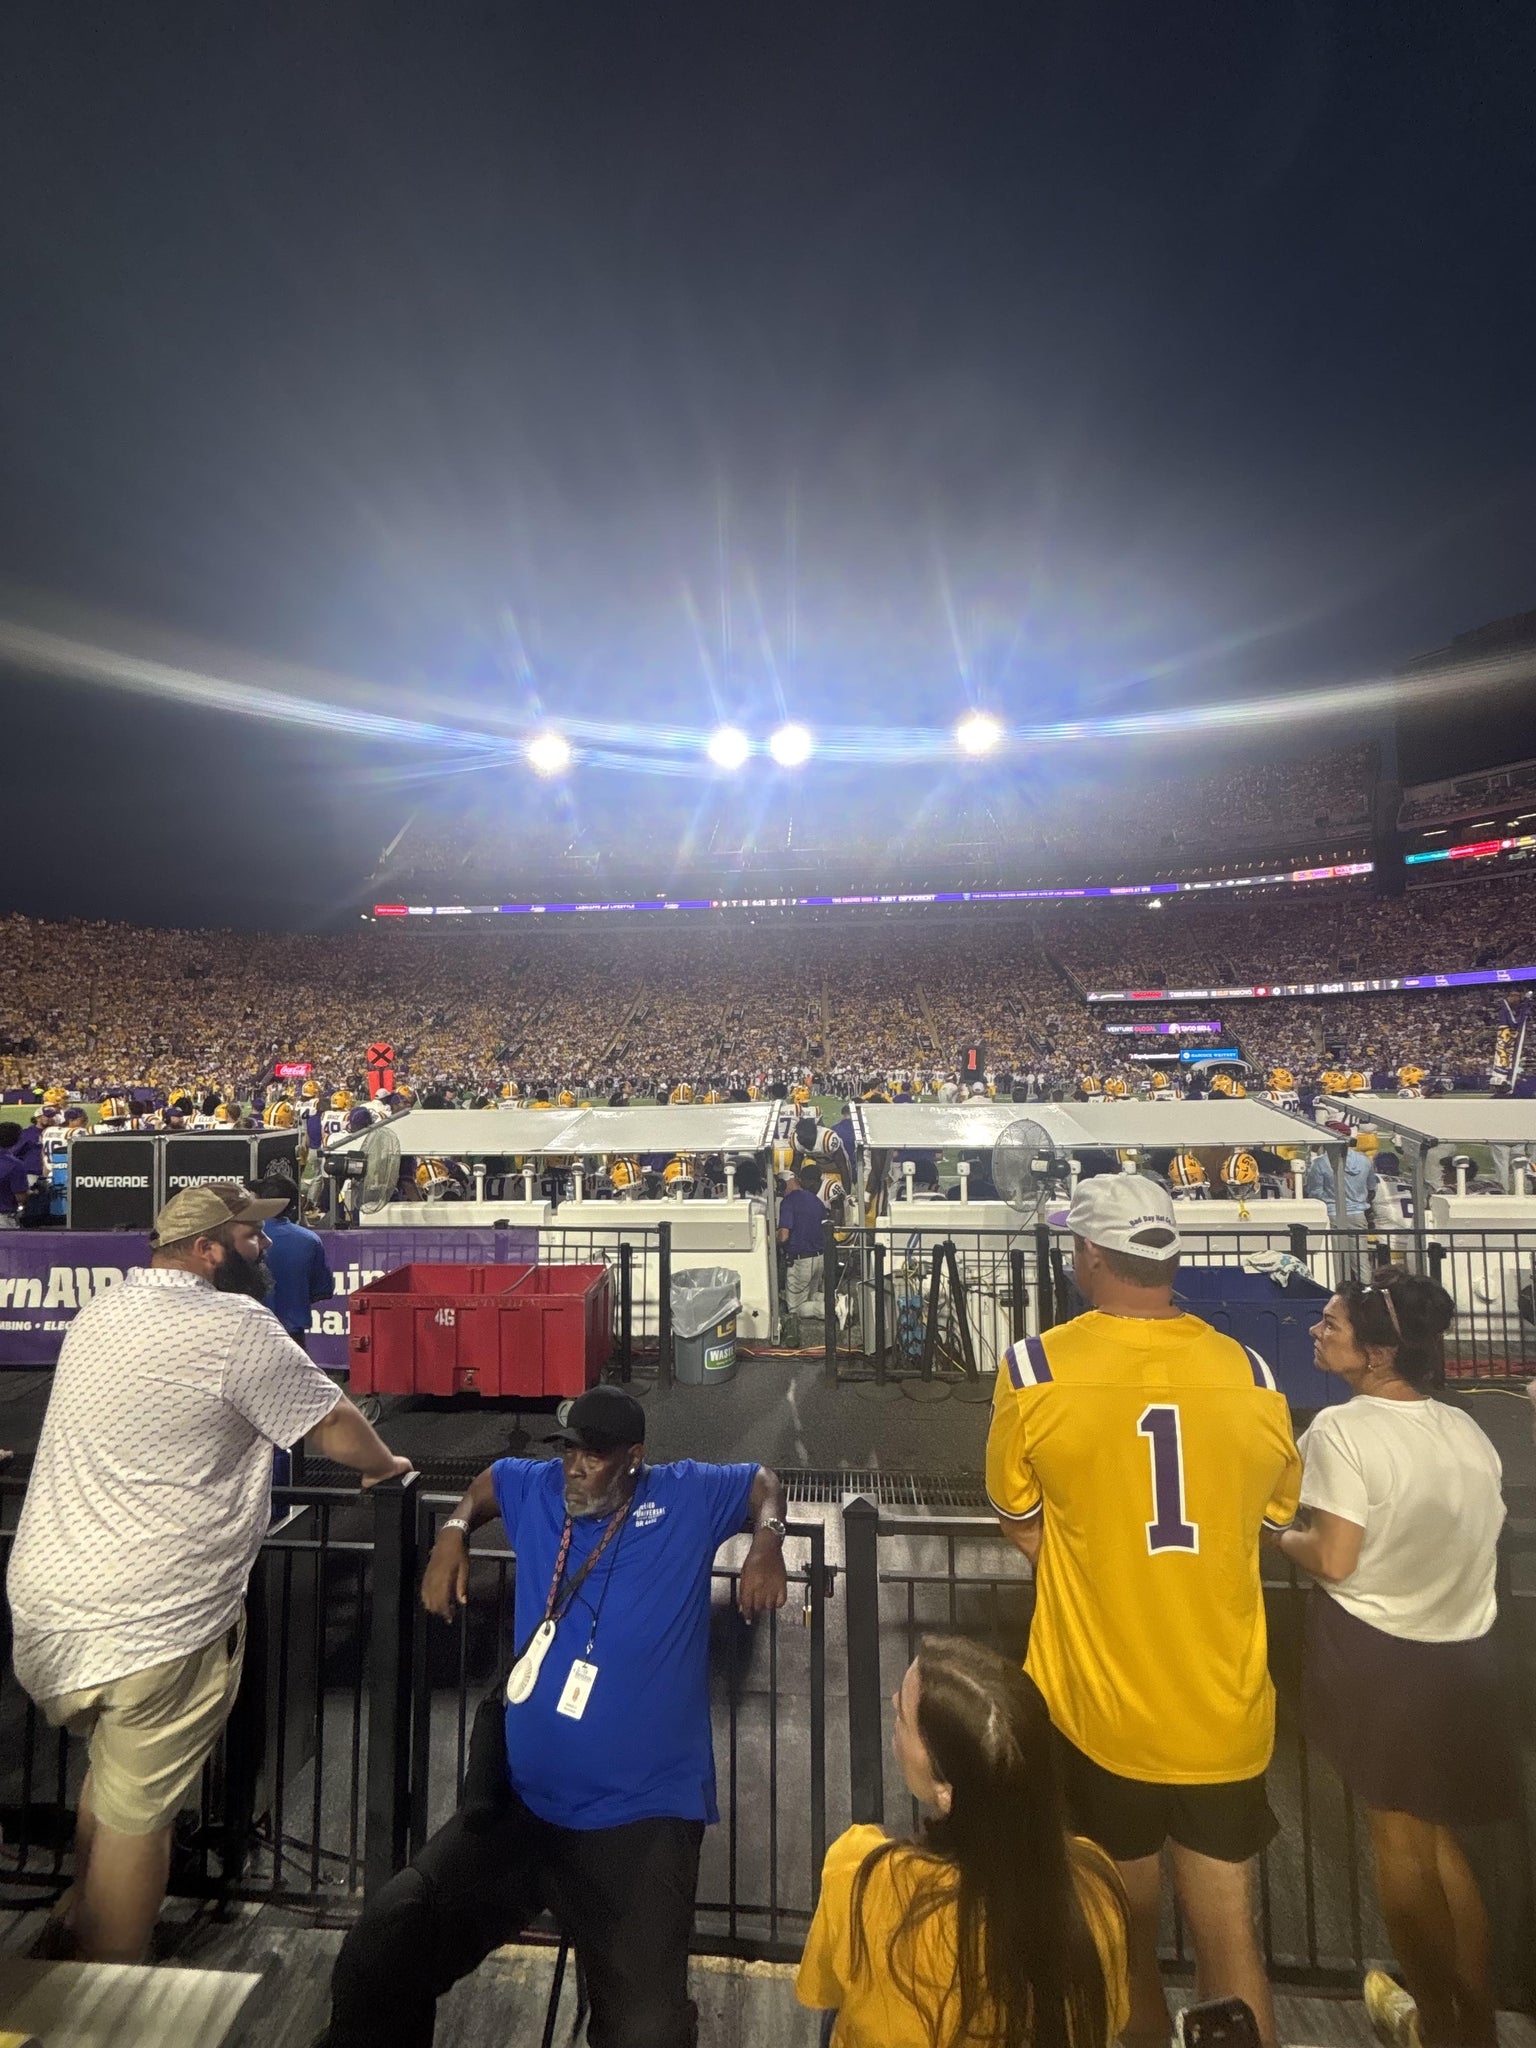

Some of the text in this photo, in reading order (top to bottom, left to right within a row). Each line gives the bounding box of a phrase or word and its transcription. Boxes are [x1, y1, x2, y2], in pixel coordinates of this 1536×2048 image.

[967, 1049, 977, 1070] 1
[75, 1175, 150, 1188] POWERADE
[1136, 1403, 1199, 1556] 1
